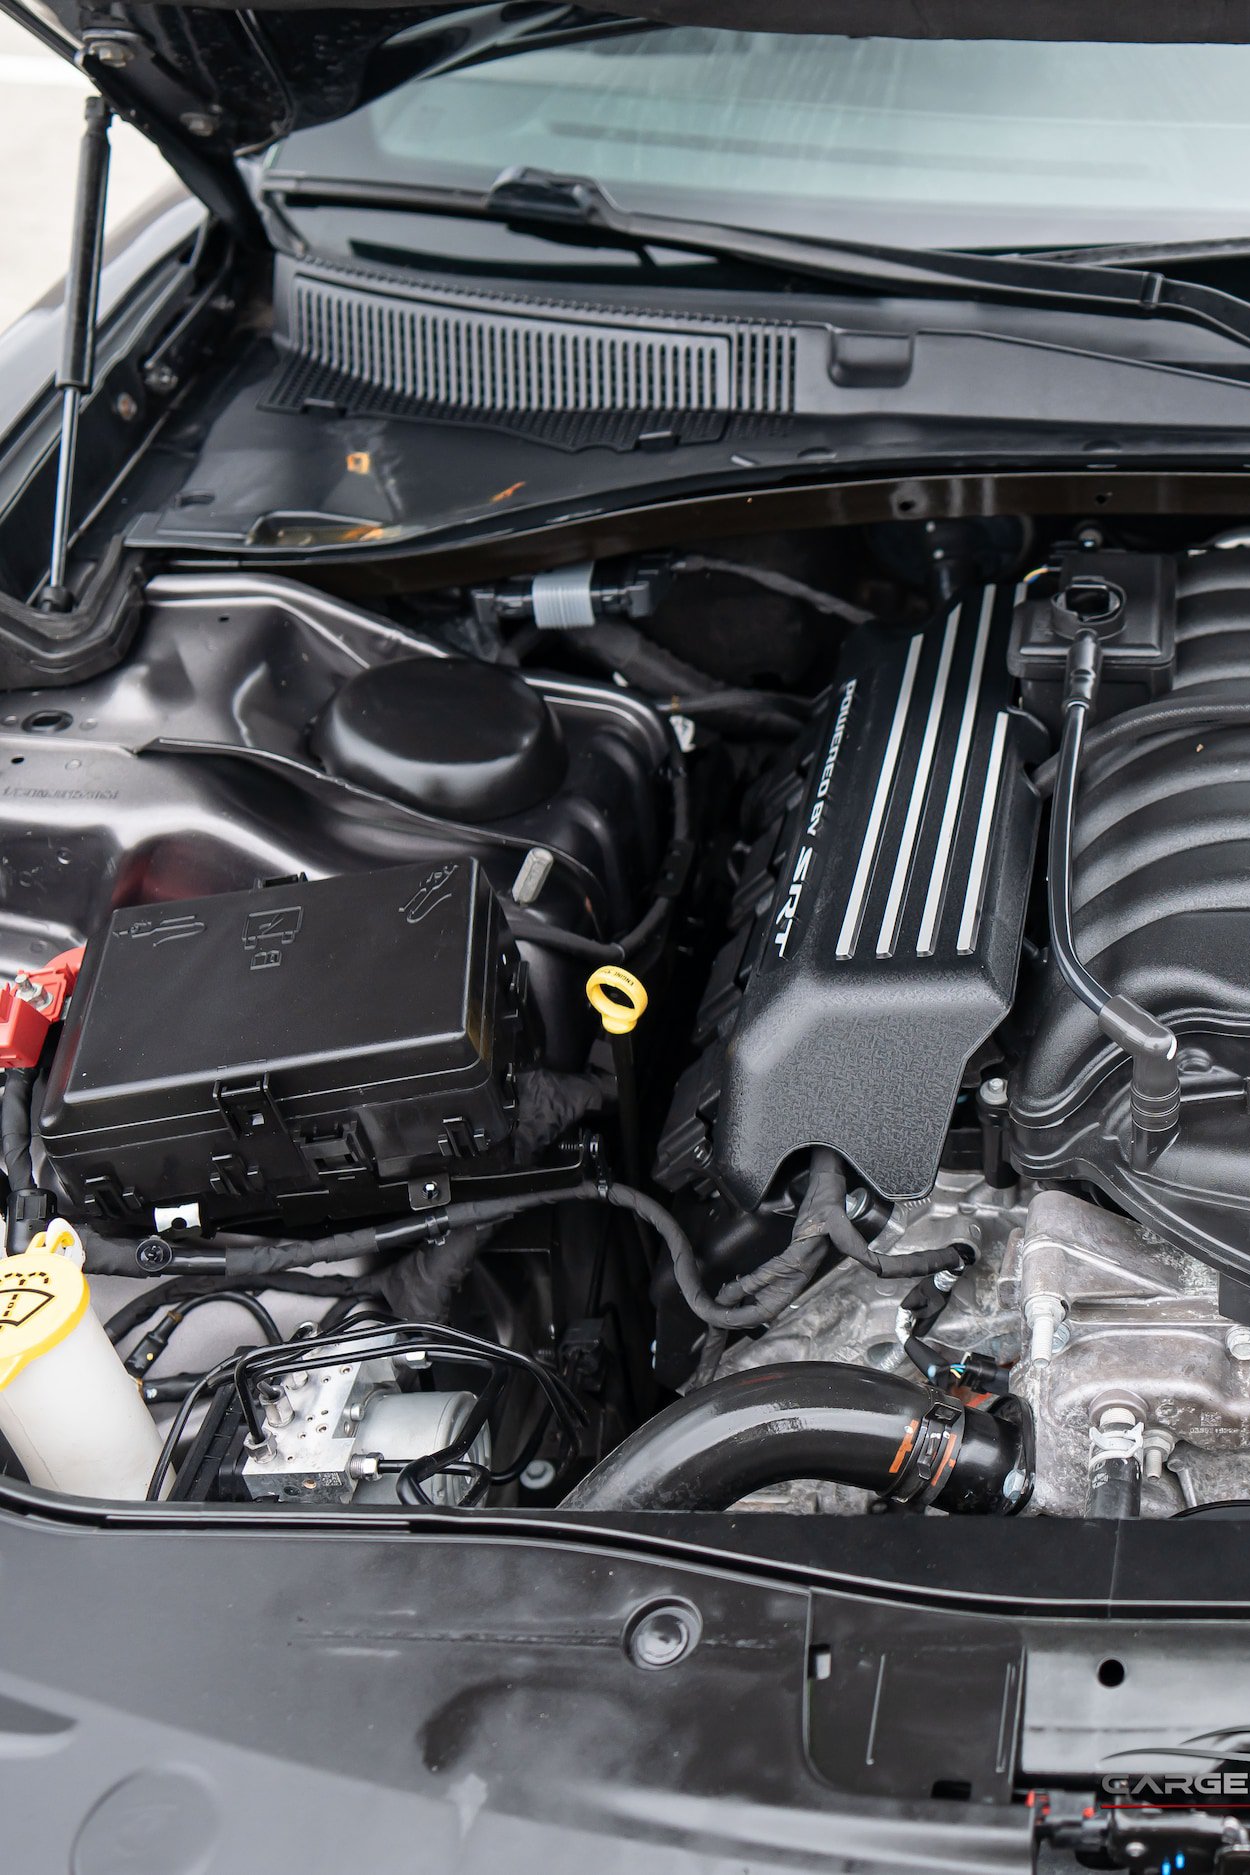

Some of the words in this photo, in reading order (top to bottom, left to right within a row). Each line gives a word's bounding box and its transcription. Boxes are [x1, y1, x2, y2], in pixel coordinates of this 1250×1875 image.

[816, 679, 858, 798] POWERED
[807, 801, 824, 837] BY
[774, 846, 813, 958] SRT
